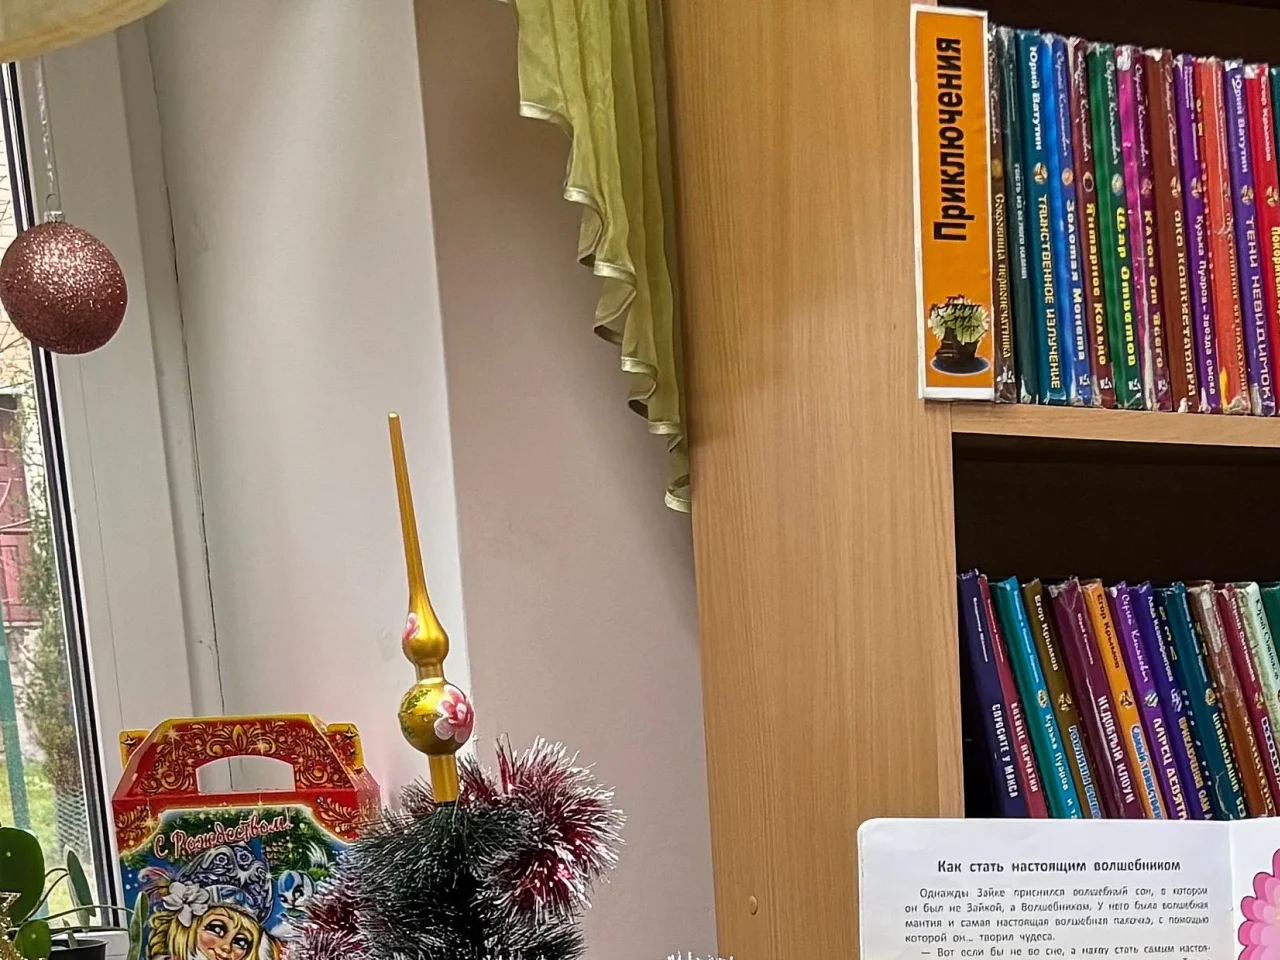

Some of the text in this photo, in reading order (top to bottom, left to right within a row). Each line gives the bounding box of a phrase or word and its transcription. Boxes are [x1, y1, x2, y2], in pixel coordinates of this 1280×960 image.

[933, 36, 967, 242] Приключения
[938, 858, 1181, 874] Как стать настоящим волшебником
